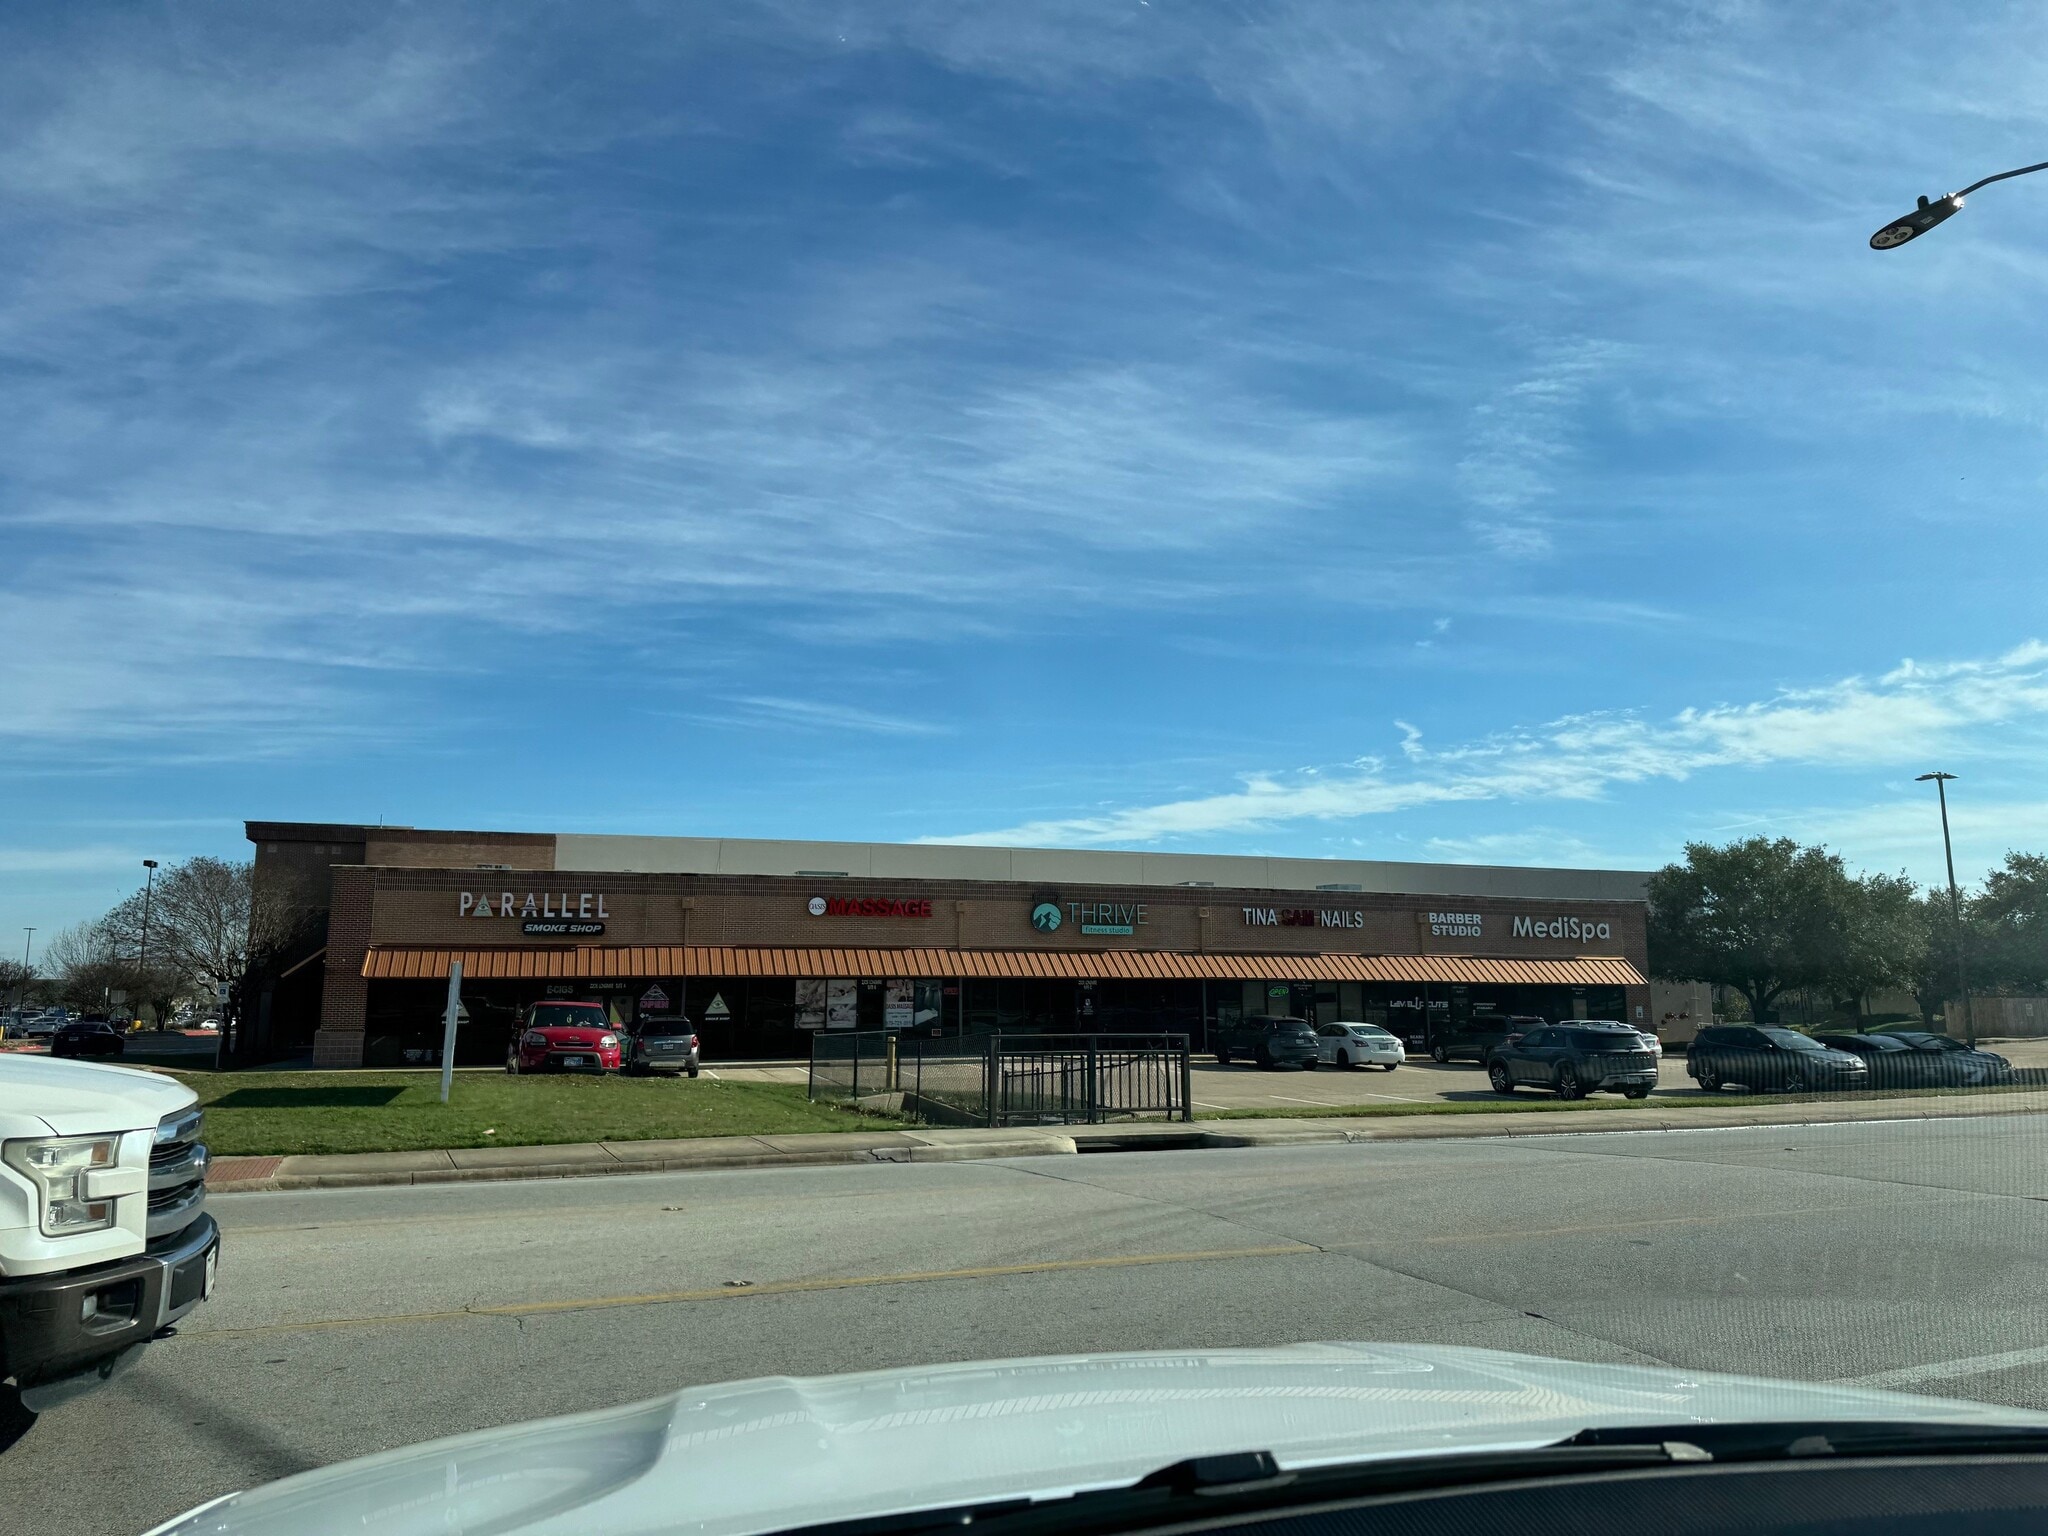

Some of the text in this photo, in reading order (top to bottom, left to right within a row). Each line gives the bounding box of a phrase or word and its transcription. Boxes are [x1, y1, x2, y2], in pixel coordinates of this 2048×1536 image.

[459, 892, 610, 918] PARALLEL
[828, 896, 932, 917] MASSAGE
[1066, 902, 1149, 925] THRIVE
[1242, 908, 1364, 928] TINA SAM NAILS
[1428, 912, 1482, 924] BARBER
[524, 923, 602, 933] SMOKE SHOP
[1109, 926, 1130, 934] studio
[1431, 925, 1482, 937] STUDIO
[1512, 916, 1611, 944] MediSpa
[639, 1000, 669, 1009] OPEN
